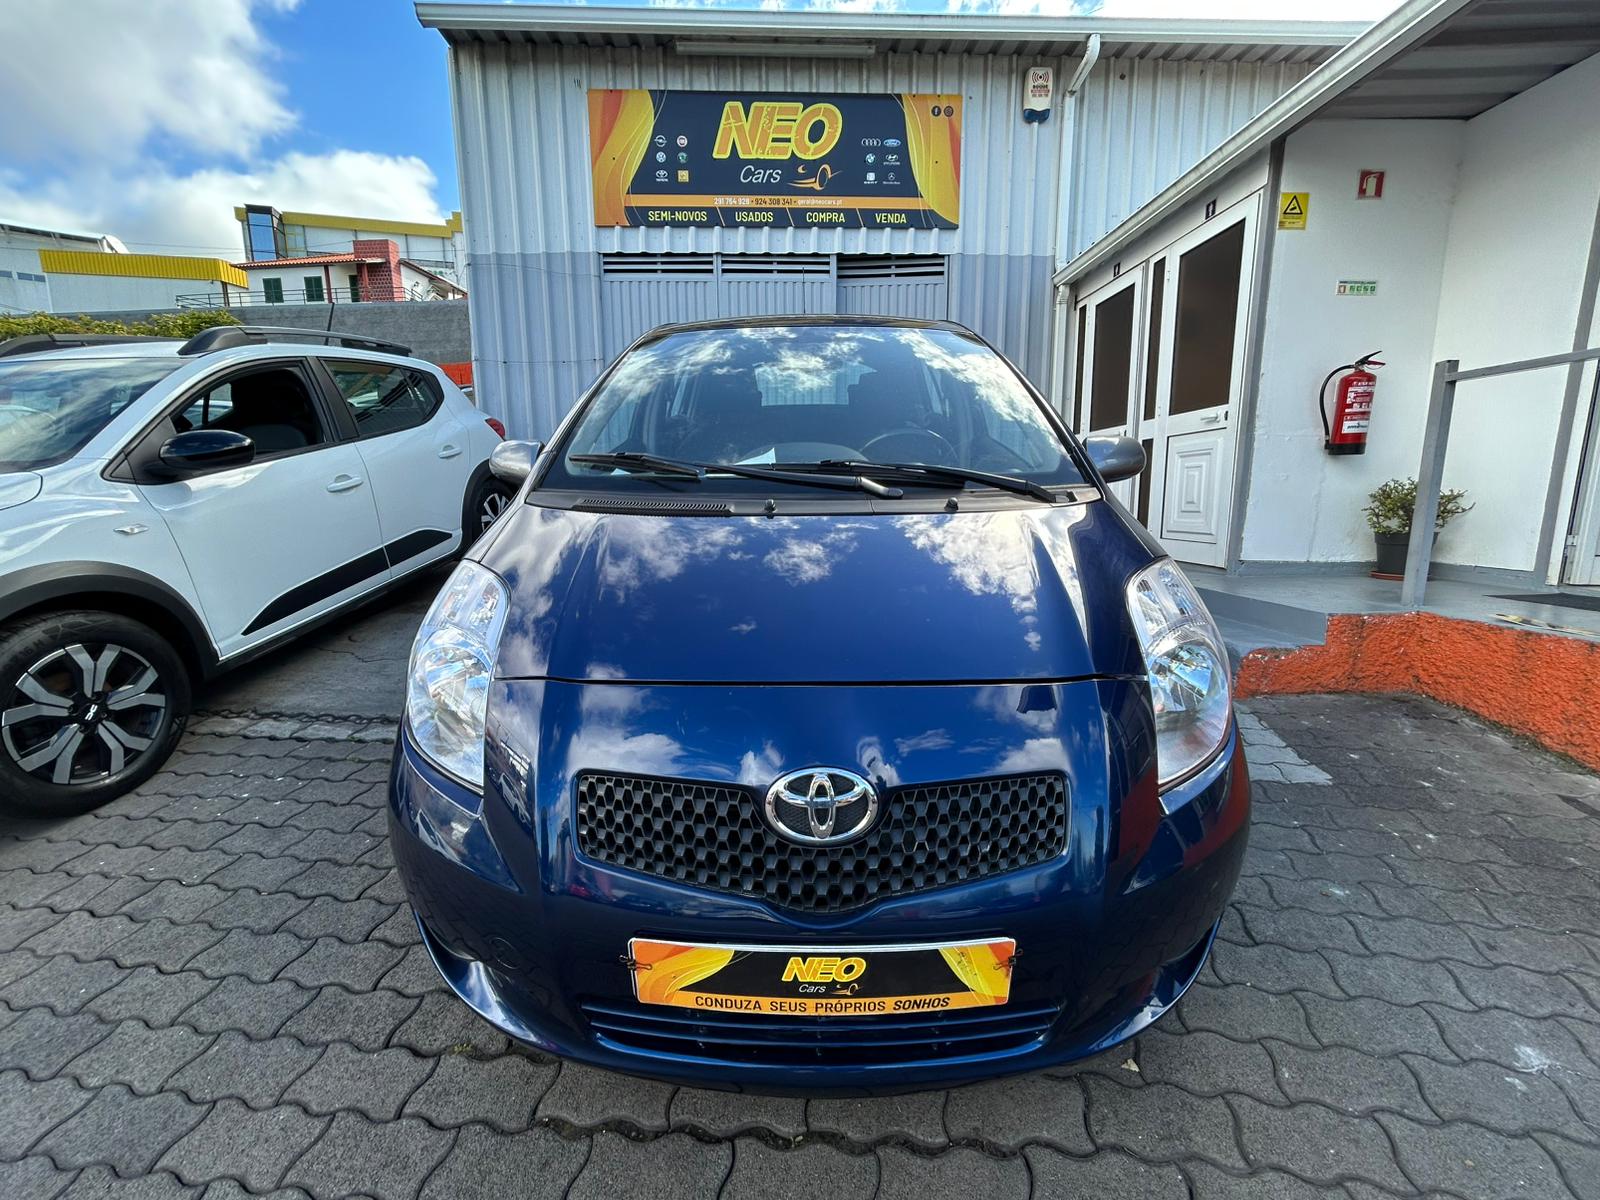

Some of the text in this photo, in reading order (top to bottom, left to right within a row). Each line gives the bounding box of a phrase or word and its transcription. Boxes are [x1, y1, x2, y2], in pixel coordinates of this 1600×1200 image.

[712, 101, 843, 160] NEO
[740, 165, 782, 183] Cars
[754, 198, 767, 206] 924
[648, 210, 708, 222] SEMI-NOVOS
[735, 211, 774, 222] USADOS
[806, 212, 846, 223] COMPRA
[875, 213, 907, 224] VENDA
[781, 957, 867, 983] NEO
[798, 984, 827, 993] Cars
[695, 995, 950, 1013] CONDUZA SEUS PRÓPRIOS SONHOS
